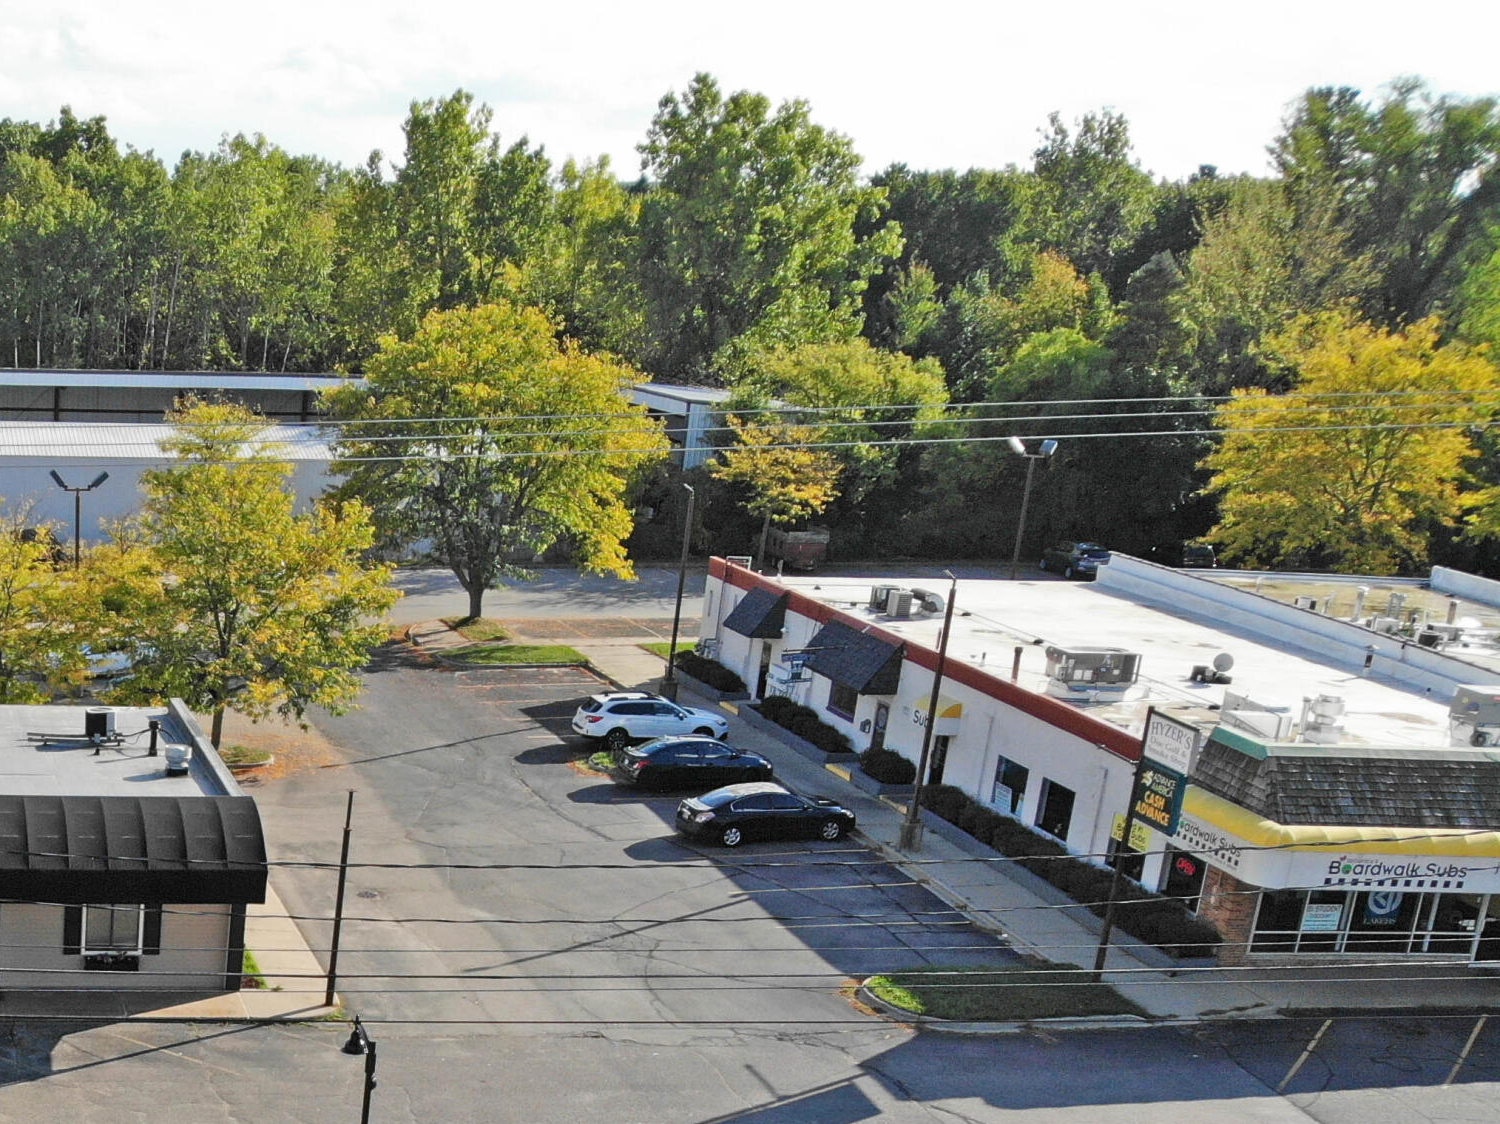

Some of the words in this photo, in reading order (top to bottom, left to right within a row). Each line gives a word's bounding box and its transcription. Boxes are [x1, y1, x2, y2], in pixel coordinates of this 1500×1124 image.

[1151, 721, 1193, 750] HYZER'S
[1144, 790, 1166, 810] CASH
[1135, 800, 1171, 827] ADVANCE
[1179, 820, 1218, 846] oardwalk
[1220, 837, 1241, 858] Subs
[1176, 857, 1196, 876] OPEN
[1328, 860, 1421, 878] Boardwalk
[1426, 862, 1467, 879] Subs
